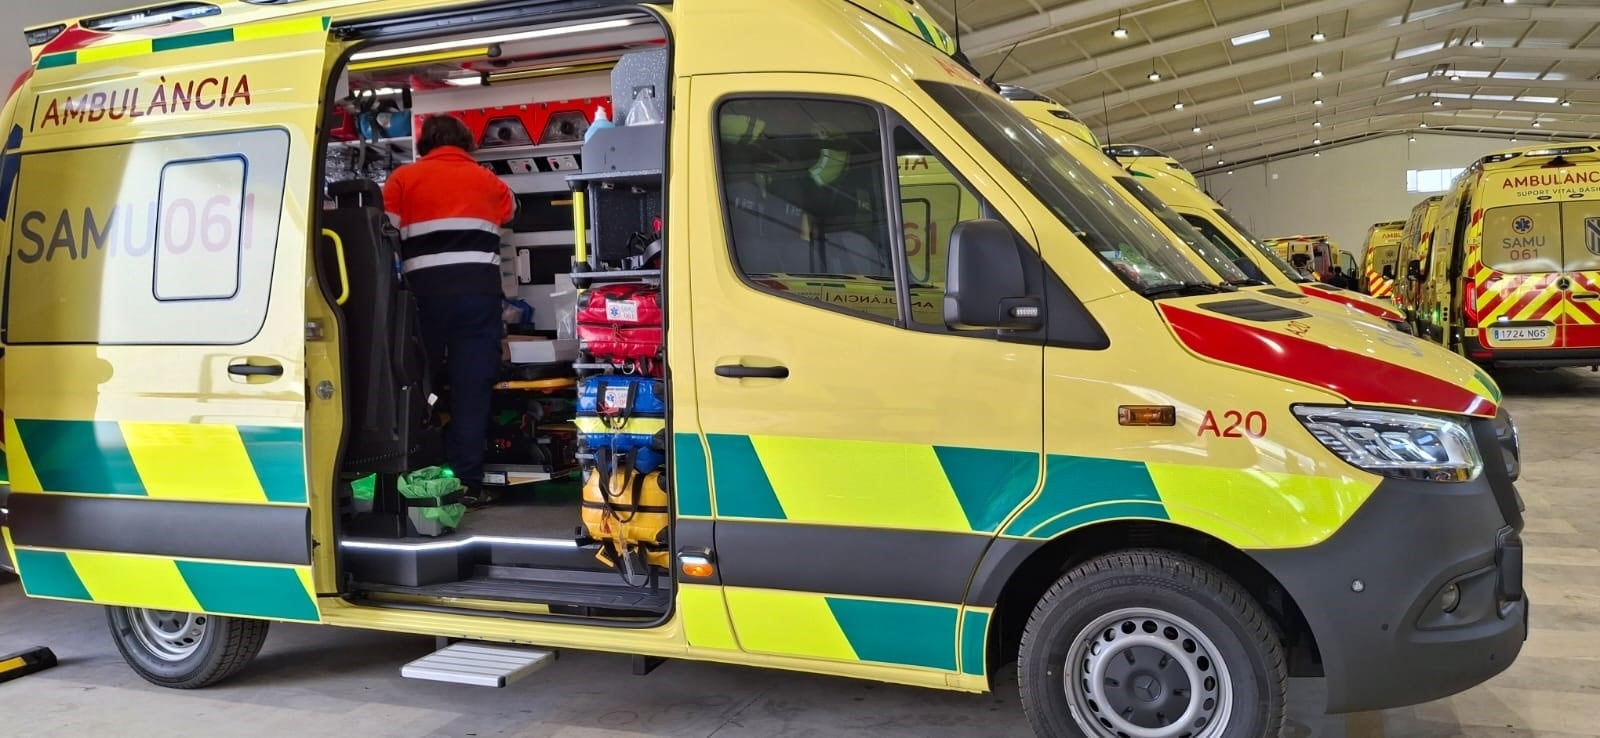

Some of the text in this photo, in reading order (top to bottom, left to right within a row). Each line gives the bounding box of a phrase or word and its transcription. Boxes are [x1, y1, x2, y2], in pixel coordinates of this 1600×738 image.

[40, 74, 251, 129] AMBULÀNCIA
[1502, 236, 1545, 249] SAMU
[1510, 249, 1539, 261] 061
[1502, 329, 1524, 339] 1724
[1527, 329, 1546, 338] NGS
[1197, 410, 1267, 439] A20
